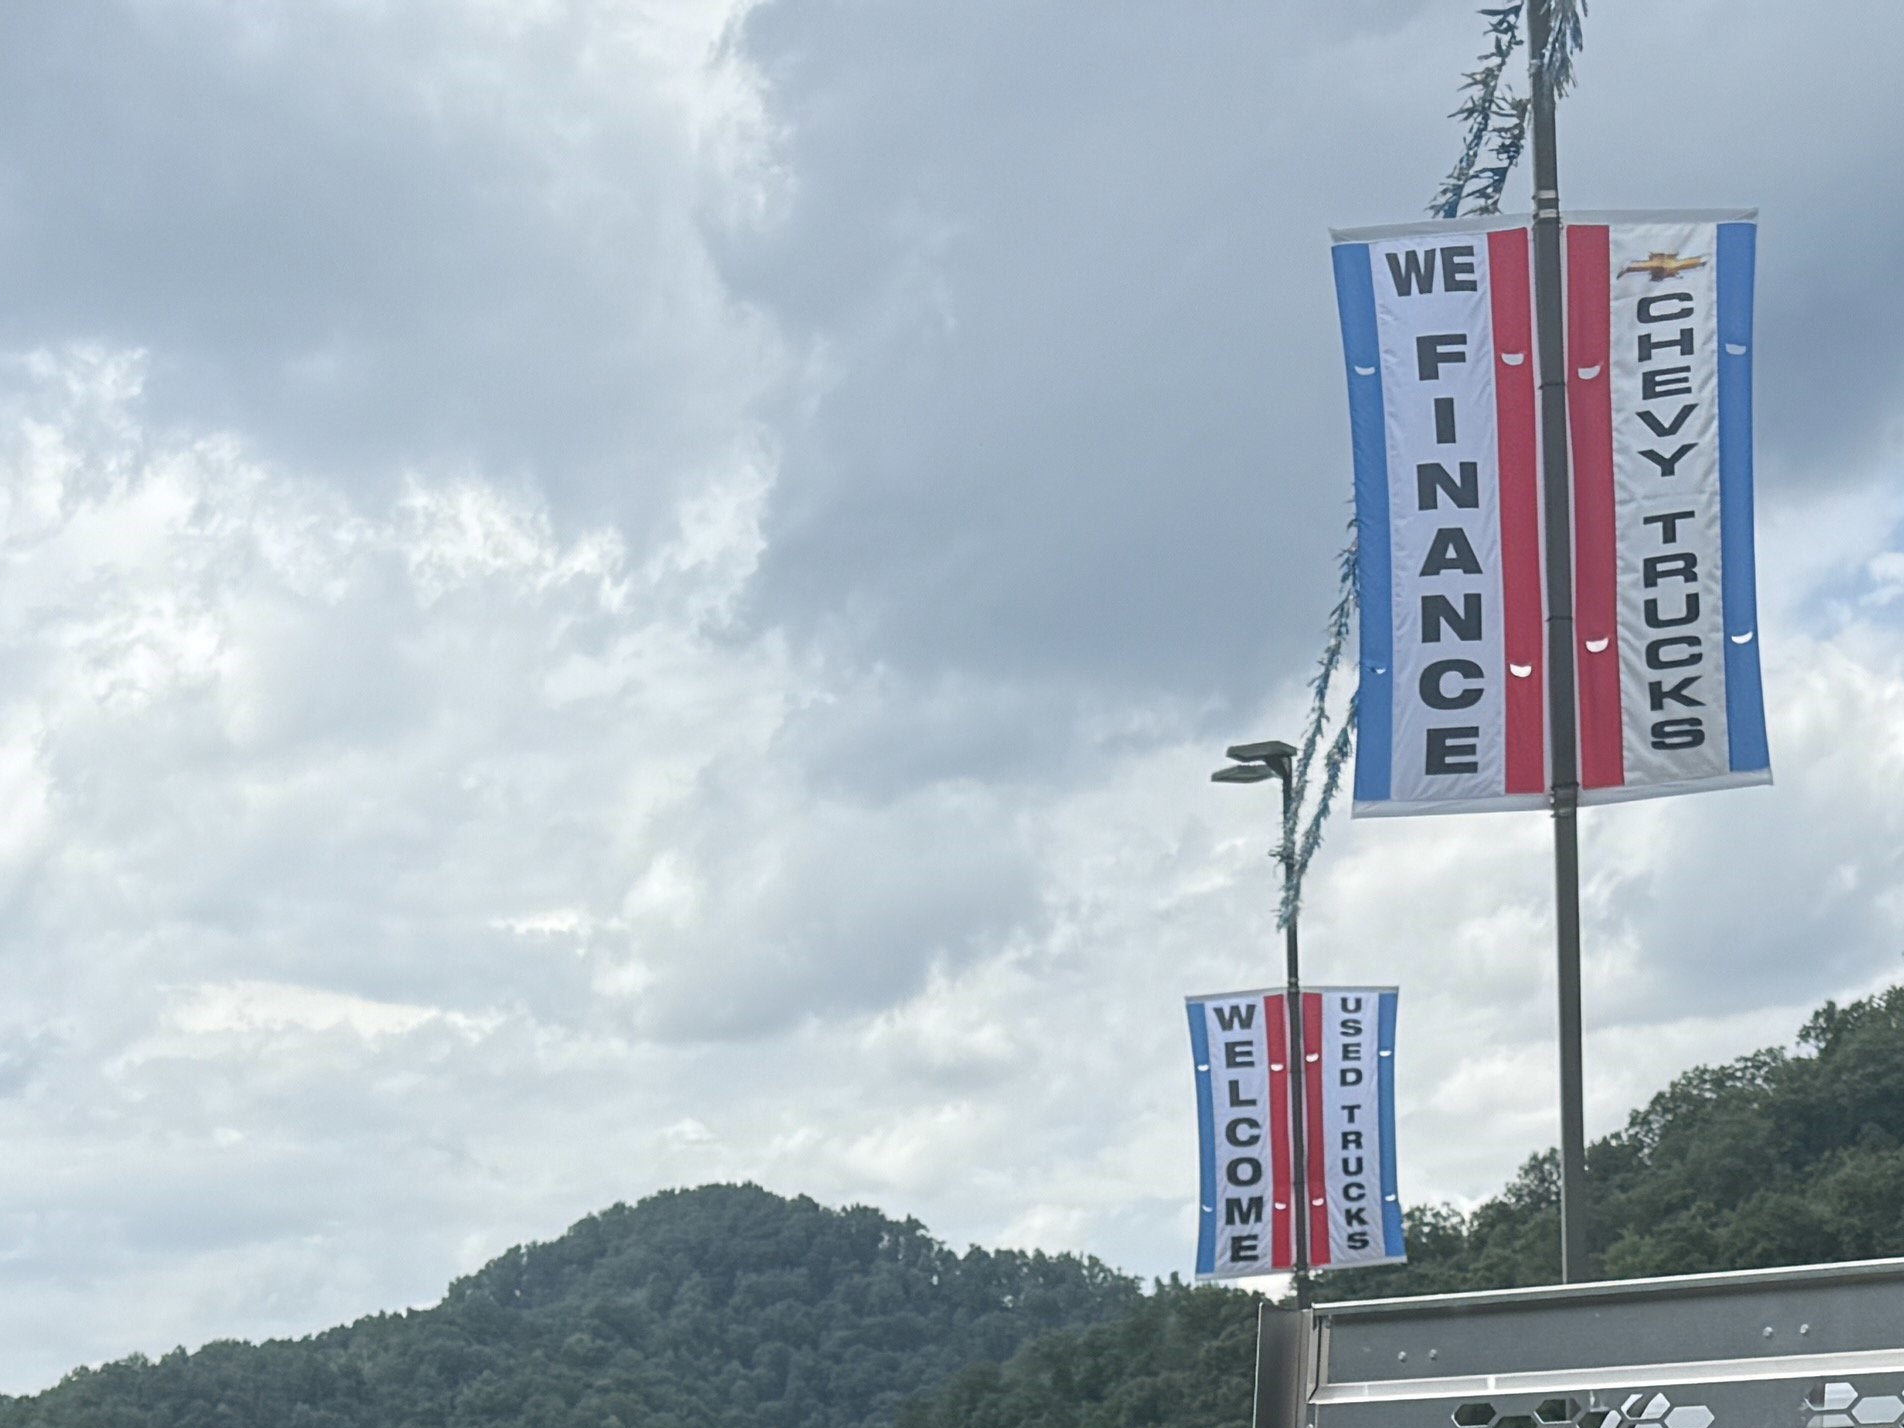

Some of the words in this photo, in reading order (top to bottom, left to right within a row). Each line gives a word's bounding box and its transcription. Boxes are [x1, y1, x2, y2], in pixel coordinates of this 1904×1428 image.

[1384, 245, 1478, 298] WE
[1635, 291, 1698, 478] CHEVY
[1415, 332, 1485, 776] FINANCE
[1643, 511, 1705, 750] TRUCKS
[1213, 1003, 1265, 1264] WELCOME
[1339, 996, 1363, 1088] USED
[1340, 1104, 1369, 1251] TRUCKS
